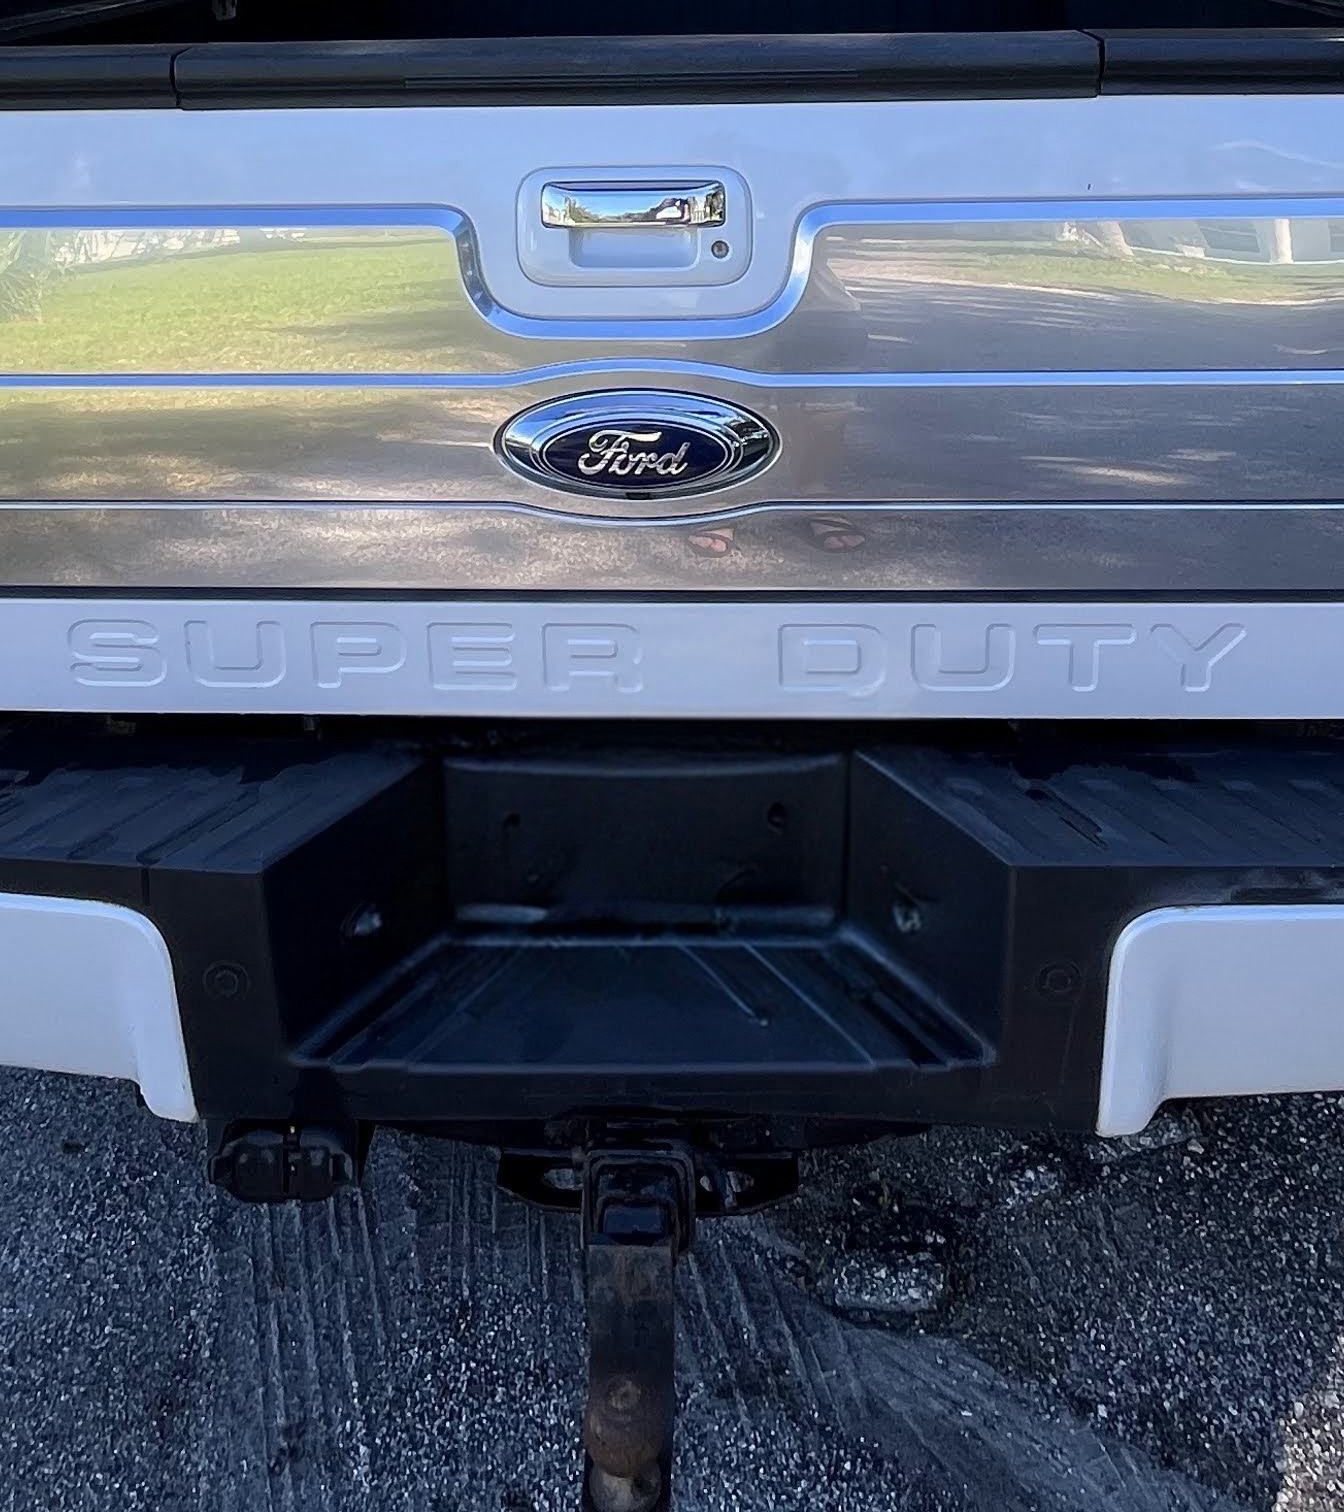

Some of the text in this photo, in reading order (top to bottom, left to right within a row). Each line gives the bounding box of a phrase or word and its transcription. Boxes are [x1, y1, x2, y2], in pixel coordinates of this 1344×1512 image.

[578, 429, 690, 475] Ford
[67, 618, 1248, 695] SUPER DUTY
